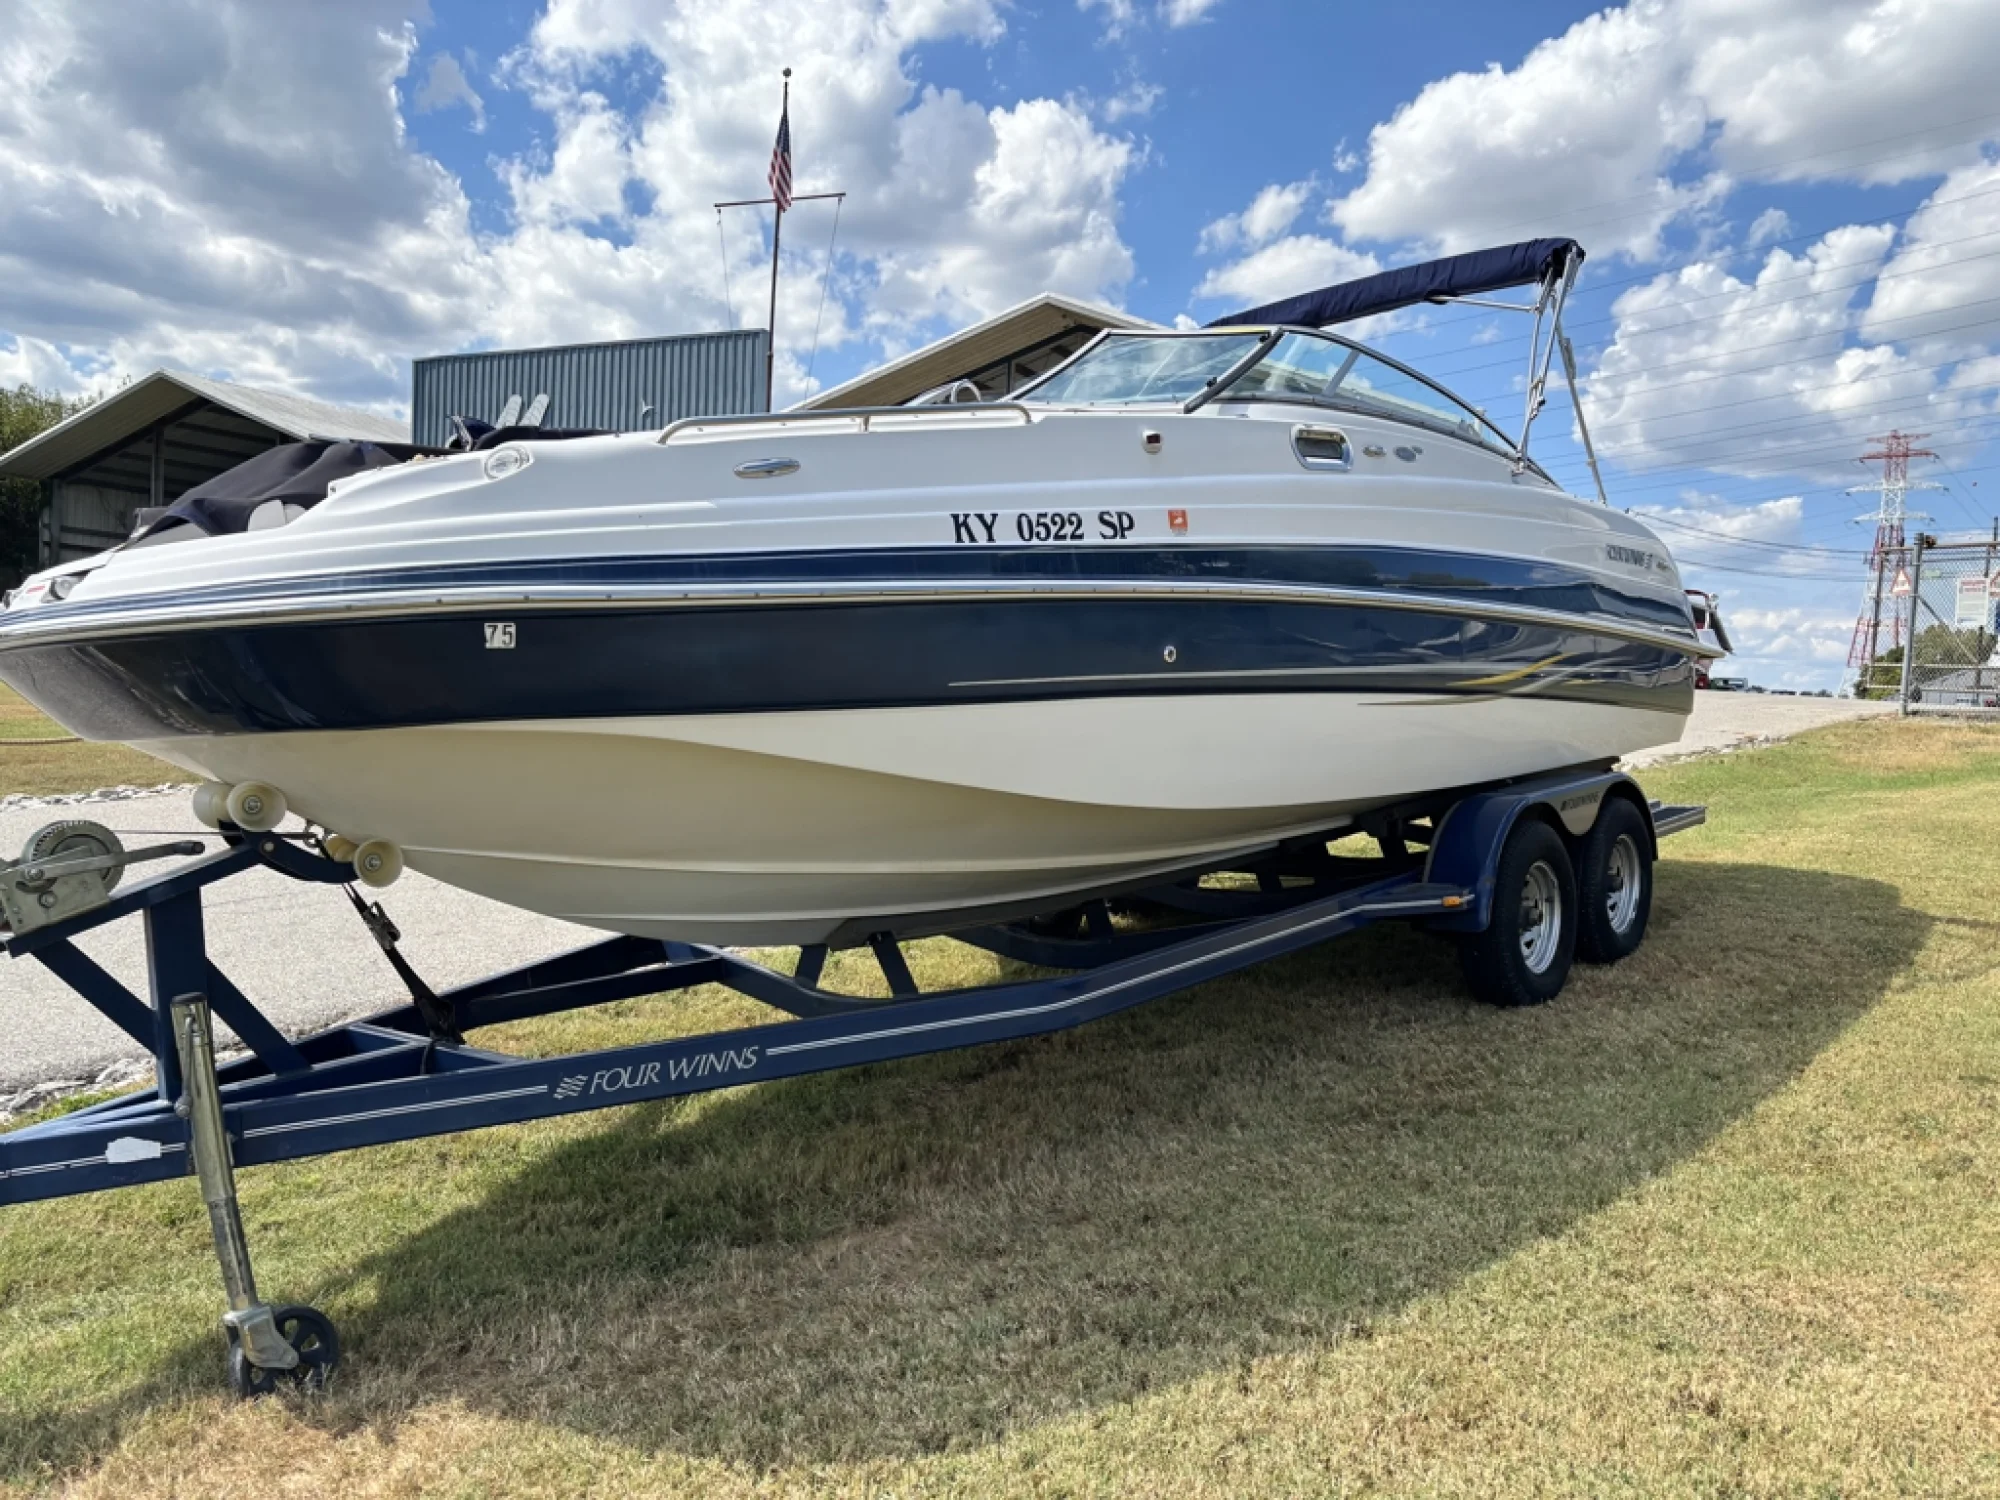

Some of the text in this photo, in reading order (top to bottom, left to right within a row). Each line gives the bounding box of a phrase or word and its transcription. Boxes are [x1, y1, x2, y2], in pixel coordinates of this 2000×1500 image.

[950, 513, 998, 543] KY
[1016, 512, 1084, 541] 0522
[1098, 510, 1135, 539] SP
[486, 624, 513, 647] 75
[589, 1045, 759, 1094] FOUR WINNS
